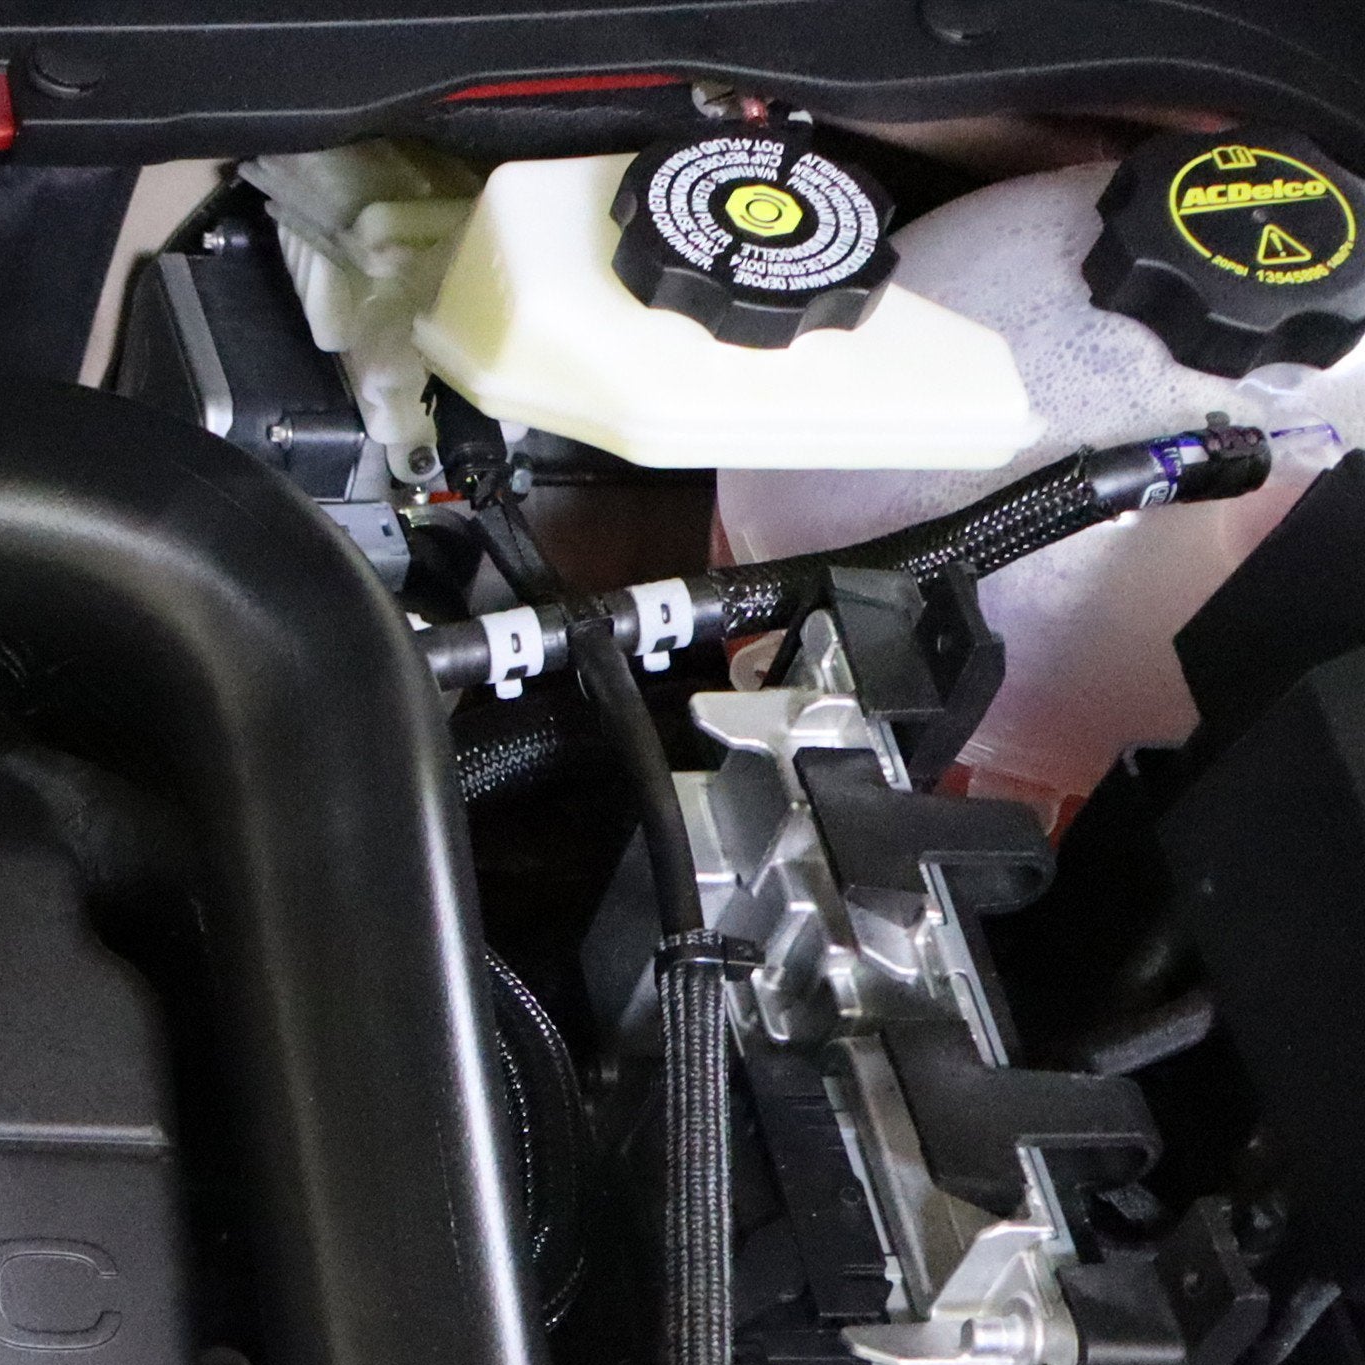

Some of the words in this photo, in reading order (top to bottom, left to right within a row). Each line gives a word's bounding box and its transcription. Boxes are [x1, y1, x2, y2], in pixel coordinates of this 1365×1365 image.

[699, 138, 741, 155] FLUID
[752, 139, 784, 155] DOT
[695, 150, 750, 172] BEFORE
[750, 152, 782, 168] CAP
[1181, 179, 1328, 209] ACDelco
[694, 212, 733, 248] FILLER
[688, 229, 725, 256] ONLY
[730, 253, 743, 267] 4
[738, 258, 766, 275] DOT
